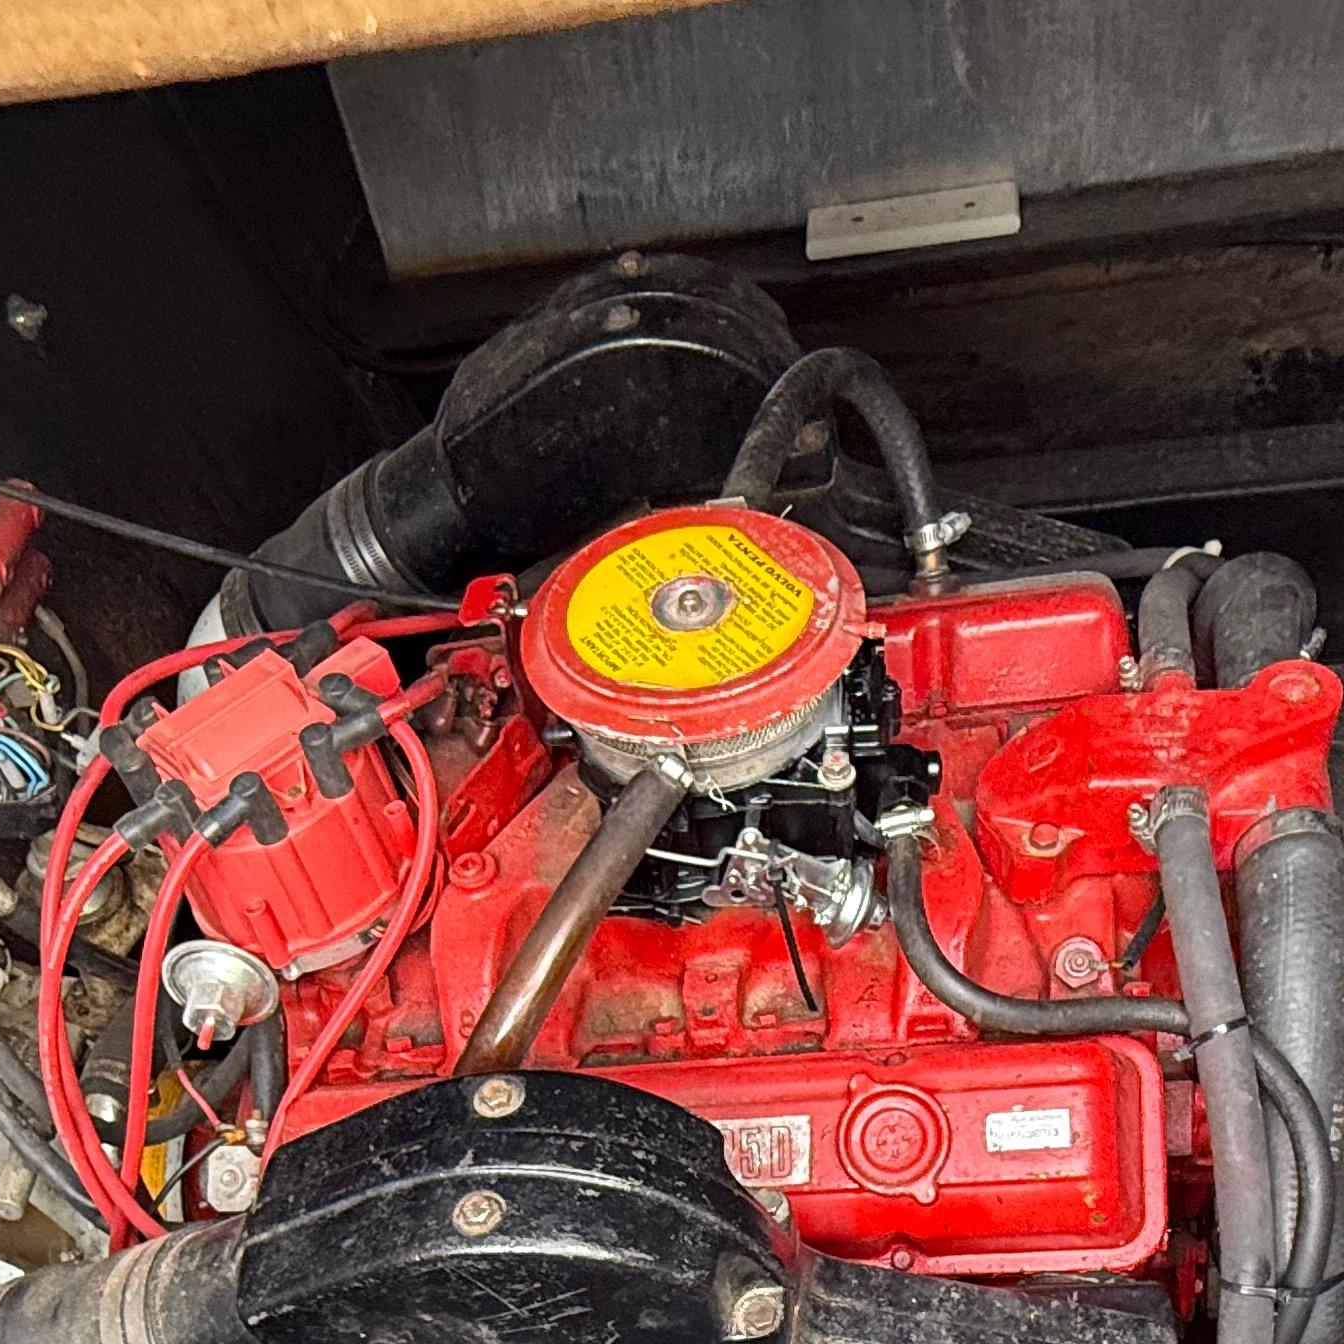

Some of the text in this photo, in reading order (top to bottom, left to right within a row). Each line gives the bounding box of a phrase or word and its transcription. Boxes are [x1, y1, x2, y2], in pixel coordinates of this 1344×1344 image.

[728, 534, 802, 598] VOLVO PENTA
[580, 637, 621, 672] IMPORTANT
